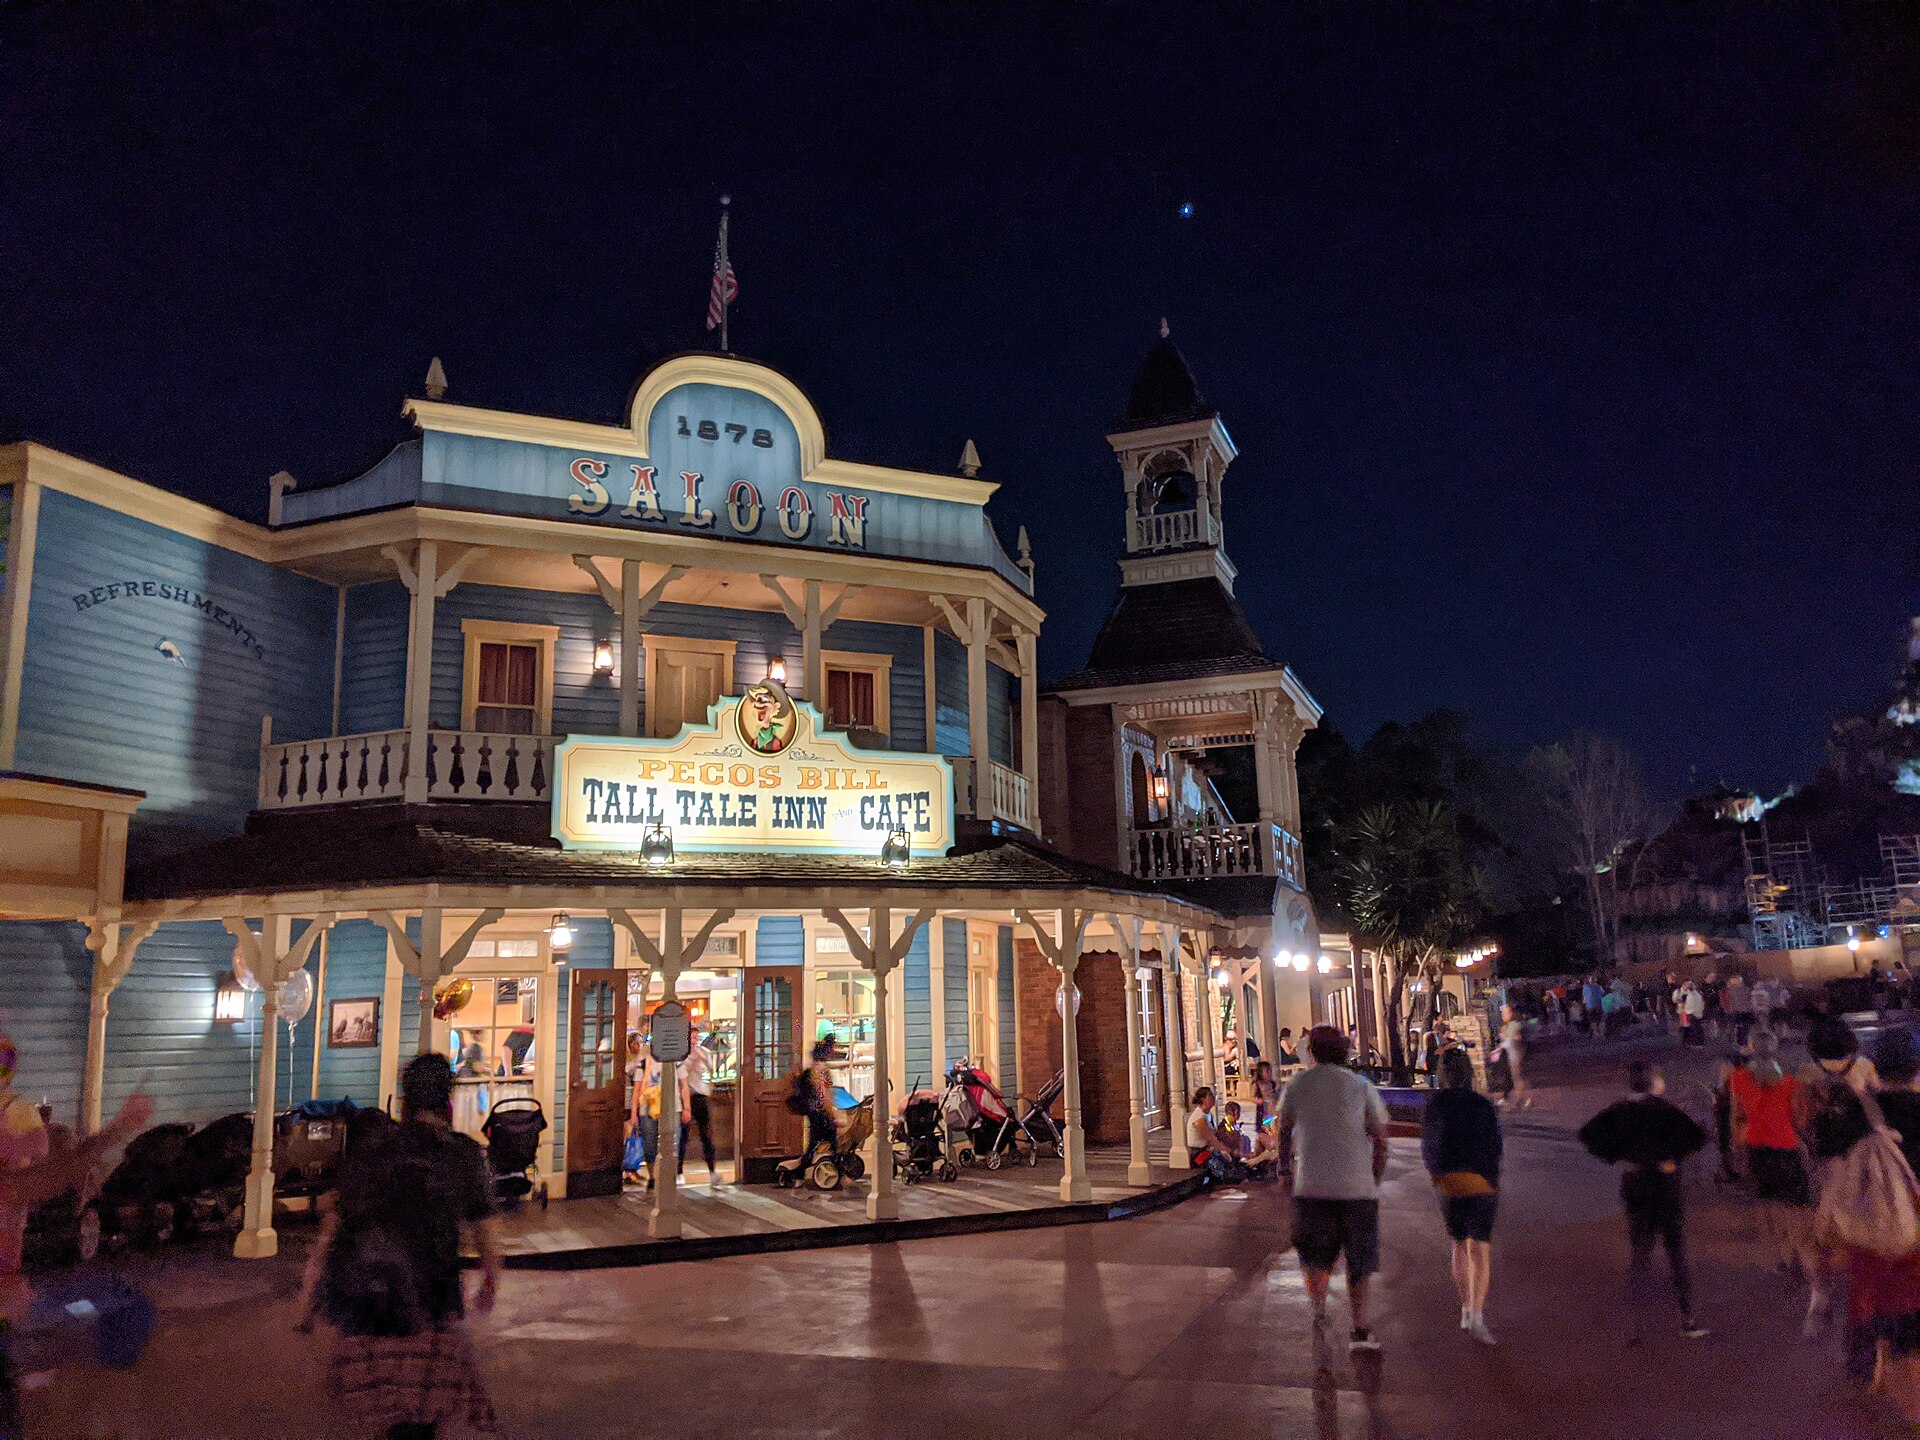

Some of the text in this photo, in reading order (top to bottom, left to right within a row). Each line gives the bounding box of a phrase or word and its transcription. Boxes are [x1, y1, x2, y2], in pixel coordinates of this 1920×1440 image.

[676, 415, 775, 449] 1878
[566, 457, 870, 549] SALOON
[72, 581, 266, 660] REFRESHMENTS
[637, 758, 889, 791] PECOS BILL
[582, 777, 664, 825] TALL
[676, 789, 758, 828] TALE
[771, 795, 828, 830] INN
[859, 791, 932, 833] CAFE
